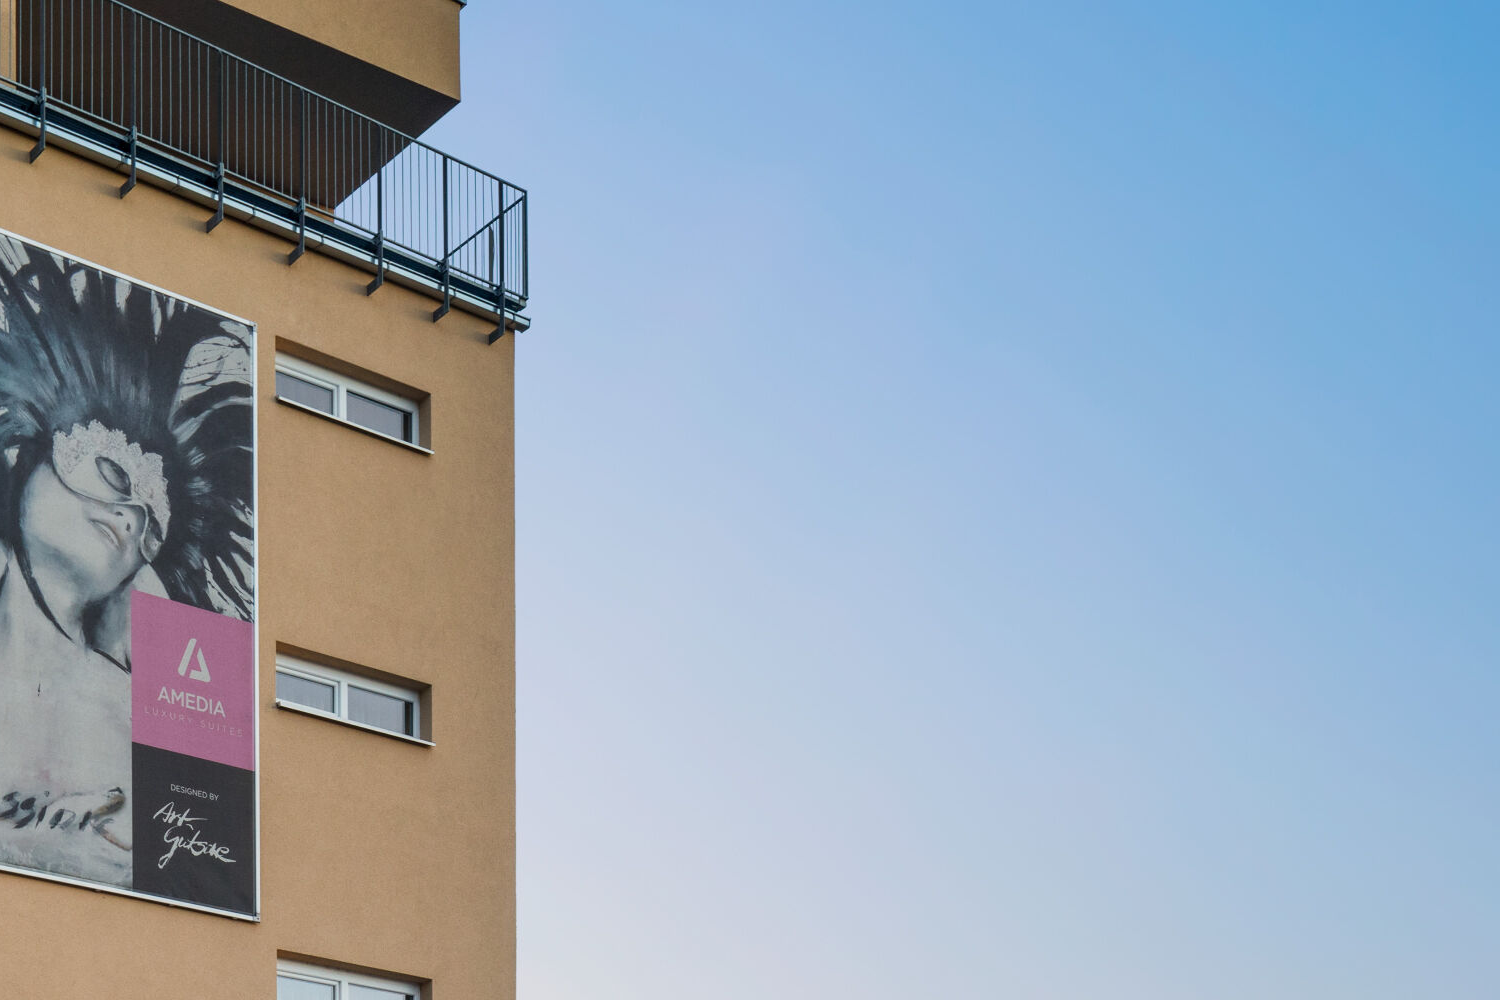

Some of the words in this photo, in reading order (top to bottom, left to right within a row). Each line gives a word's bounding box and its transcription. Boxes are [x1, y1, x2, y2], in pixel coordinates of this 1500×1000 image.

[157, 686, 227, 718] AMEDIA
[170, 783, 208, 799] DESIGNED
[209, 792, 220, 801] BY
